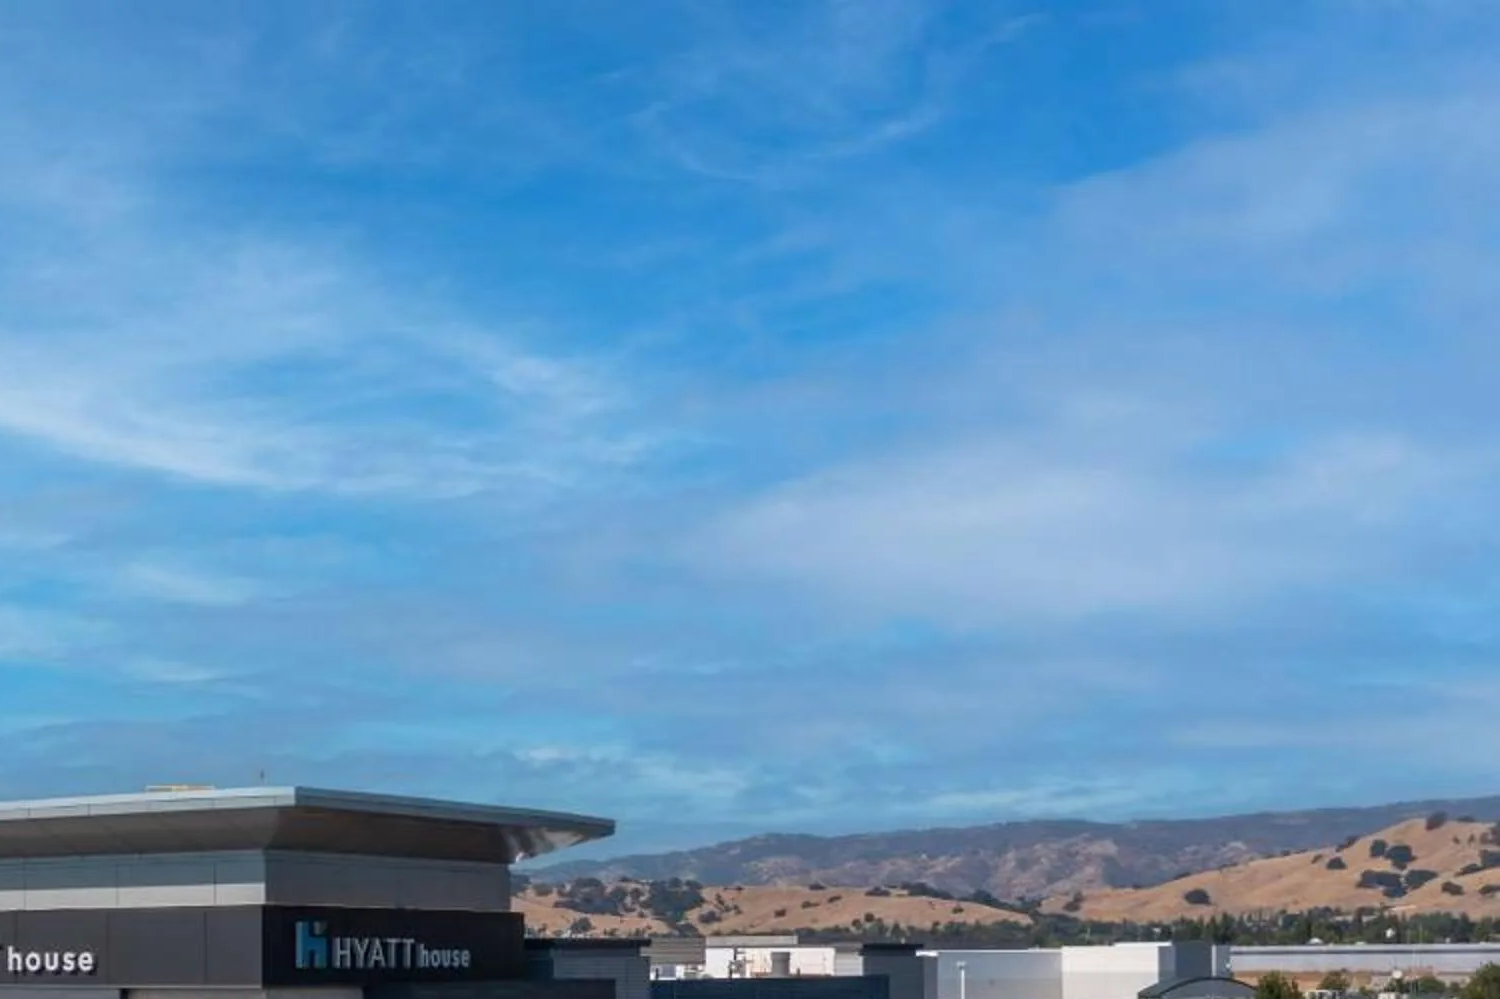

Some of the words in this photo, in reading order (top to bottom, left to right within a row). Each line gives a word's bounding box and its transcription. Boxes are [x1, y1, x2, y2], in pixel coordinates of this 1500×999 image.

[7, 945, 95, 973] house
[332, 936, 415, 969] HYATT
[419, 943, 472, 969] house
